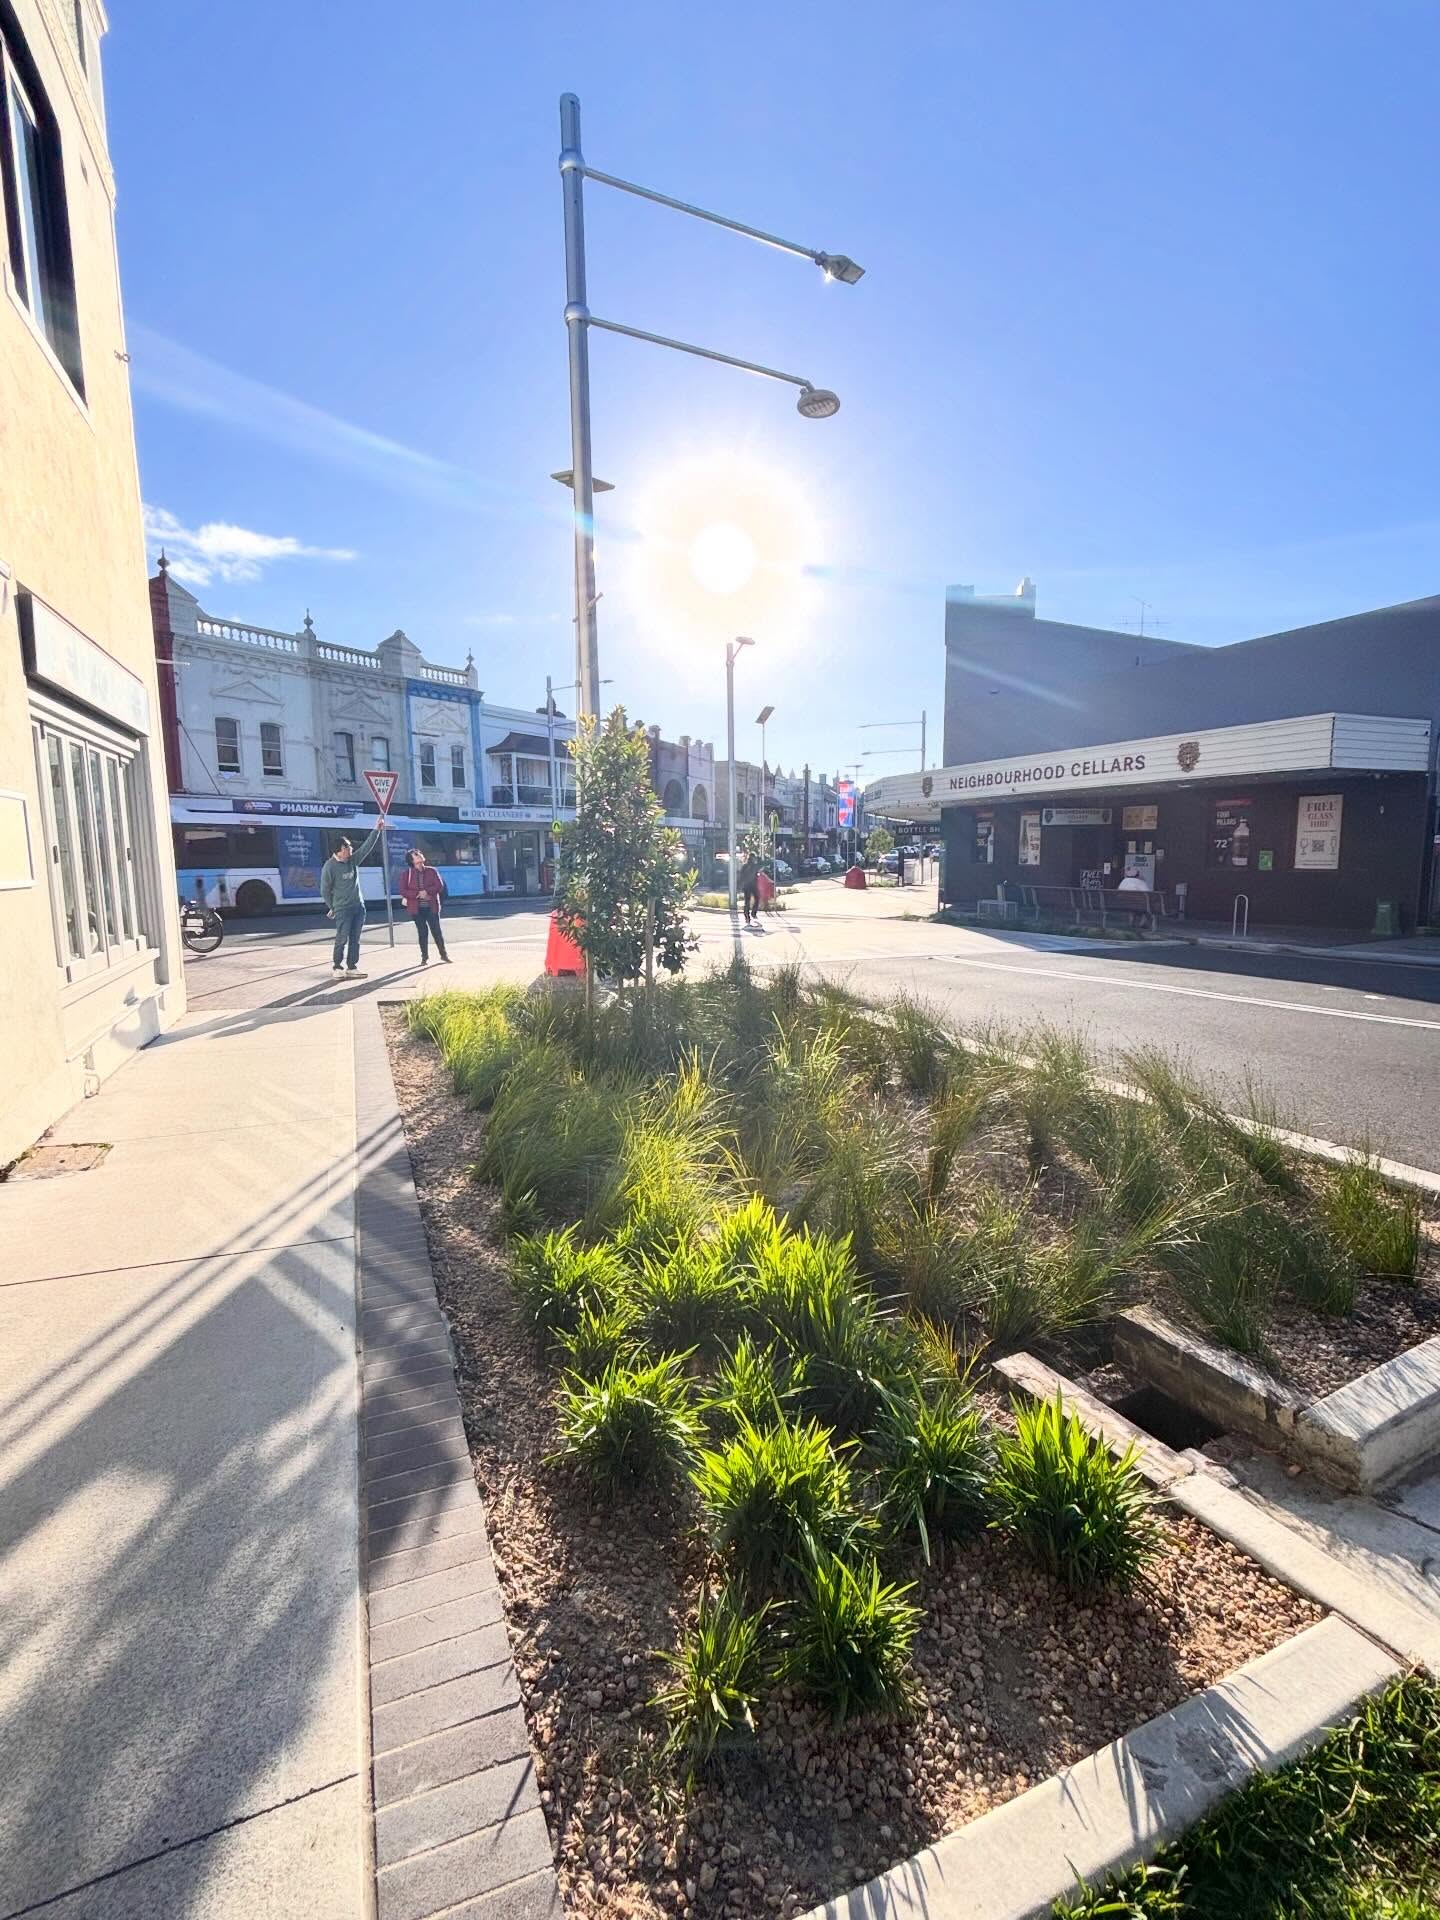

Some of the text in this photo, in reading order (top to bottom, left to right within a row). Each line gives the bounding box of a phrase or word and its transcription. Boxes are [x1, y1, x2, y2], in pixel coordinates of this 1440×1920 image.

[949, 755, 1146, 790] NEIGHBOURHOOD CELLARS
[374, 778, 390, 787] GIVE
[279, 803, 340, 815] PHARMACY
[1306, 800, 1337, 812] FREE
[471, 809, 486, 818] DRY
[1307, 811, 1334, 820] GLASS
[898, 826, 928, 834] BOTTLE
